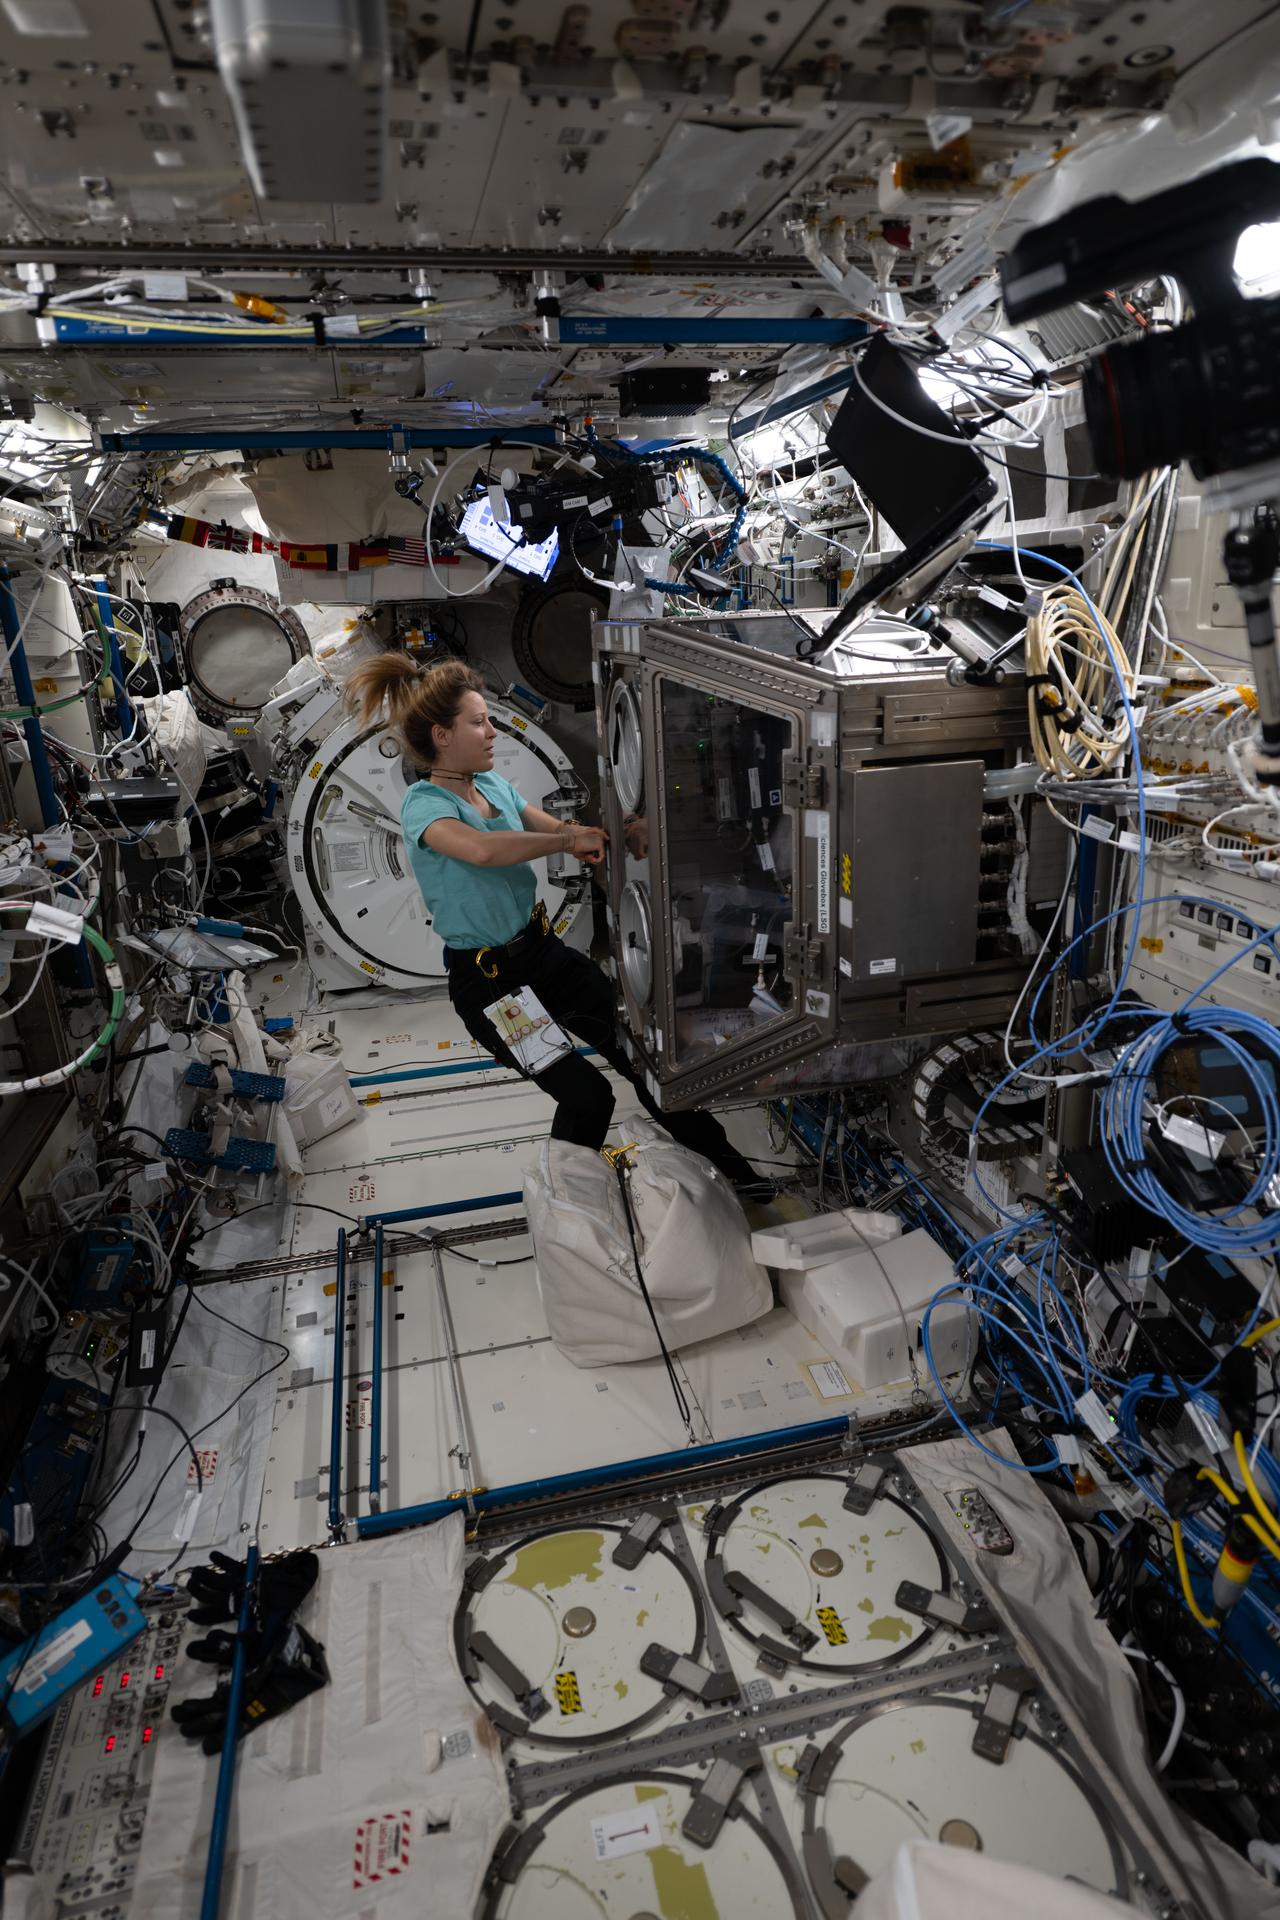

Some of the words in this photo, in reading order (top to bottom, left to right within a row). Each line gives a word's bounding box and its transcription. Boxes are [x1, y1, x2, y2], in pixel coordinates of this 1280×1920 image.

[820, 870, 828, 908] Glovebox
[820, 909, 828, 932] (LSG)
[50, 1700, 71, 1745] FREEZER
[44, 1746, 58, 1768] LAB
[32, 1772, 51, 1809] EIGHTY
[22, 1815, 40, 1849] MINUS
